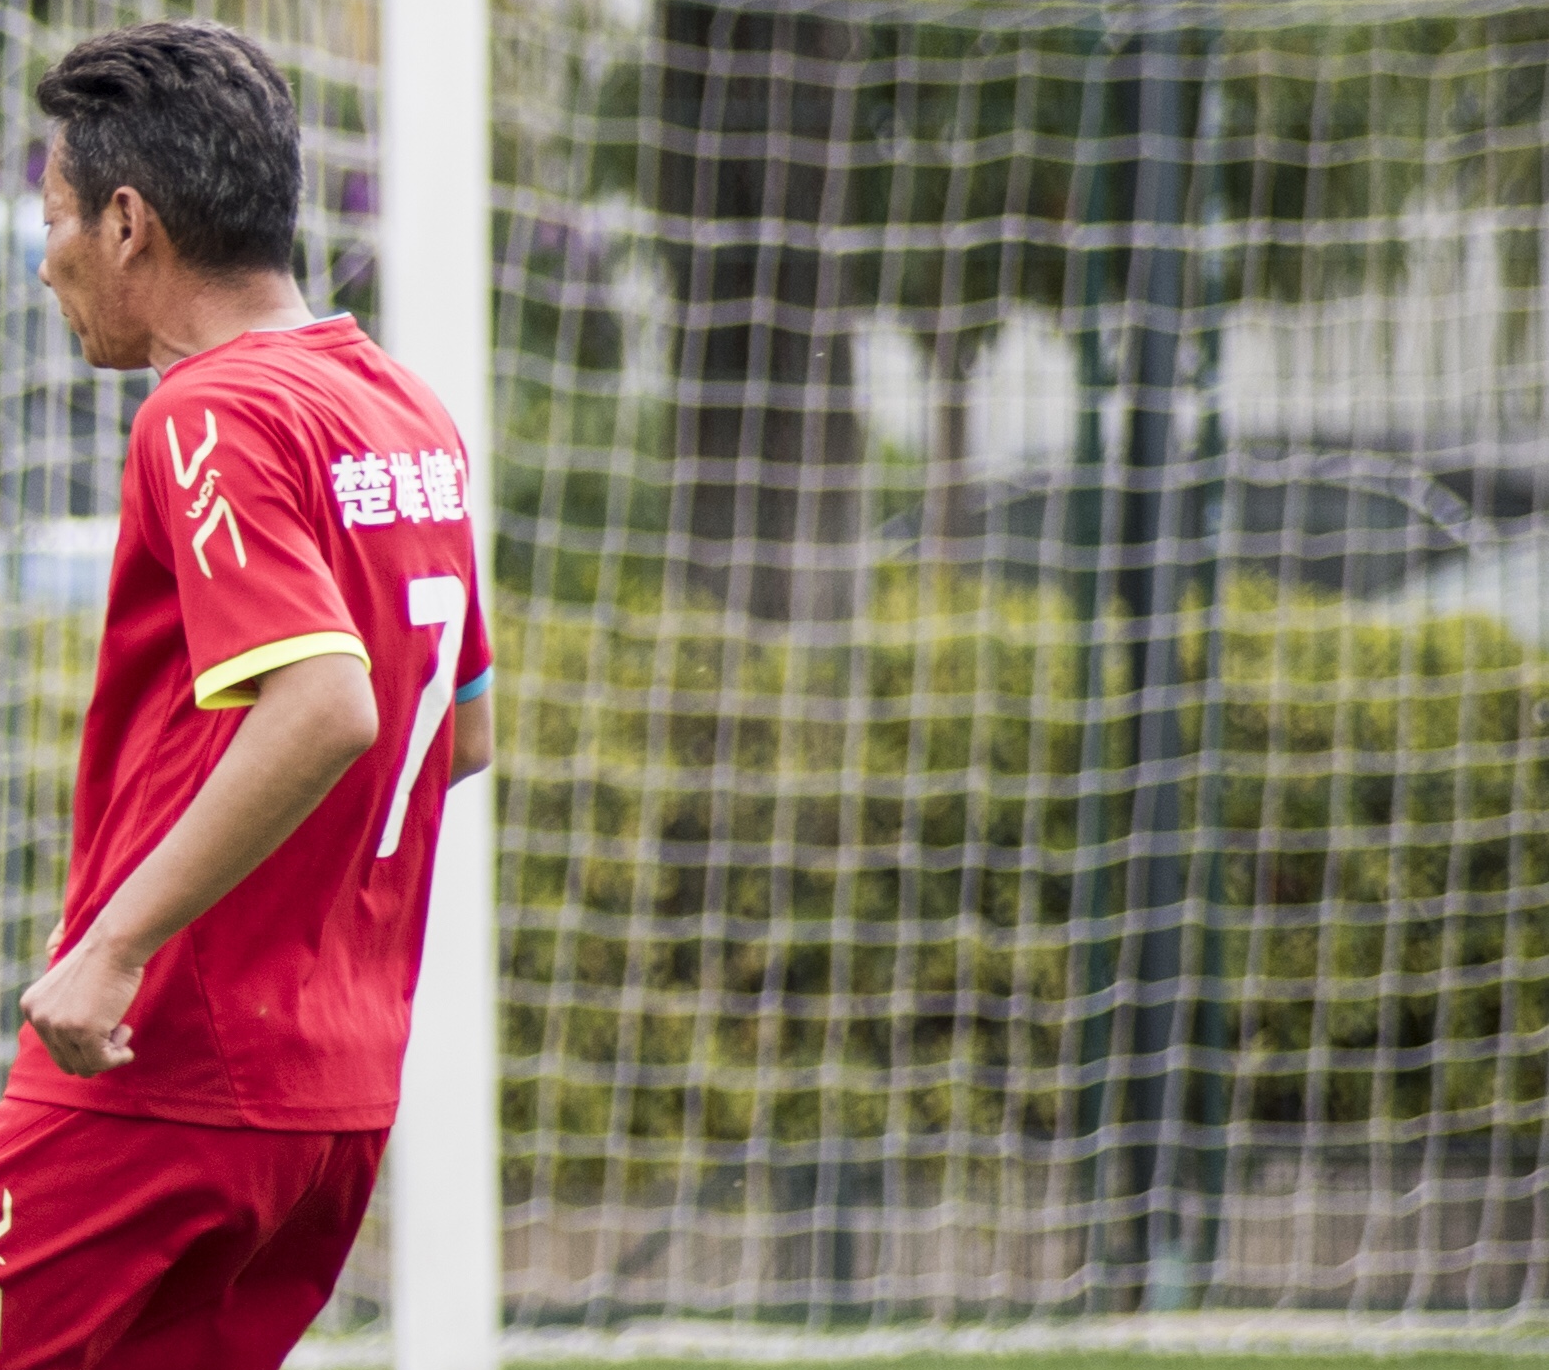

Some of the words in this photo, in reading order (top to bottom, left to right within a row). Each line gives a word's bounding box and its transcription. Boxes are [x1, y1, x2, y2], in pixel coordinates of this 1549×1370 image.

[331, 448, 471, 528] 楚雄健
[376, 575, 467, 859] 7
